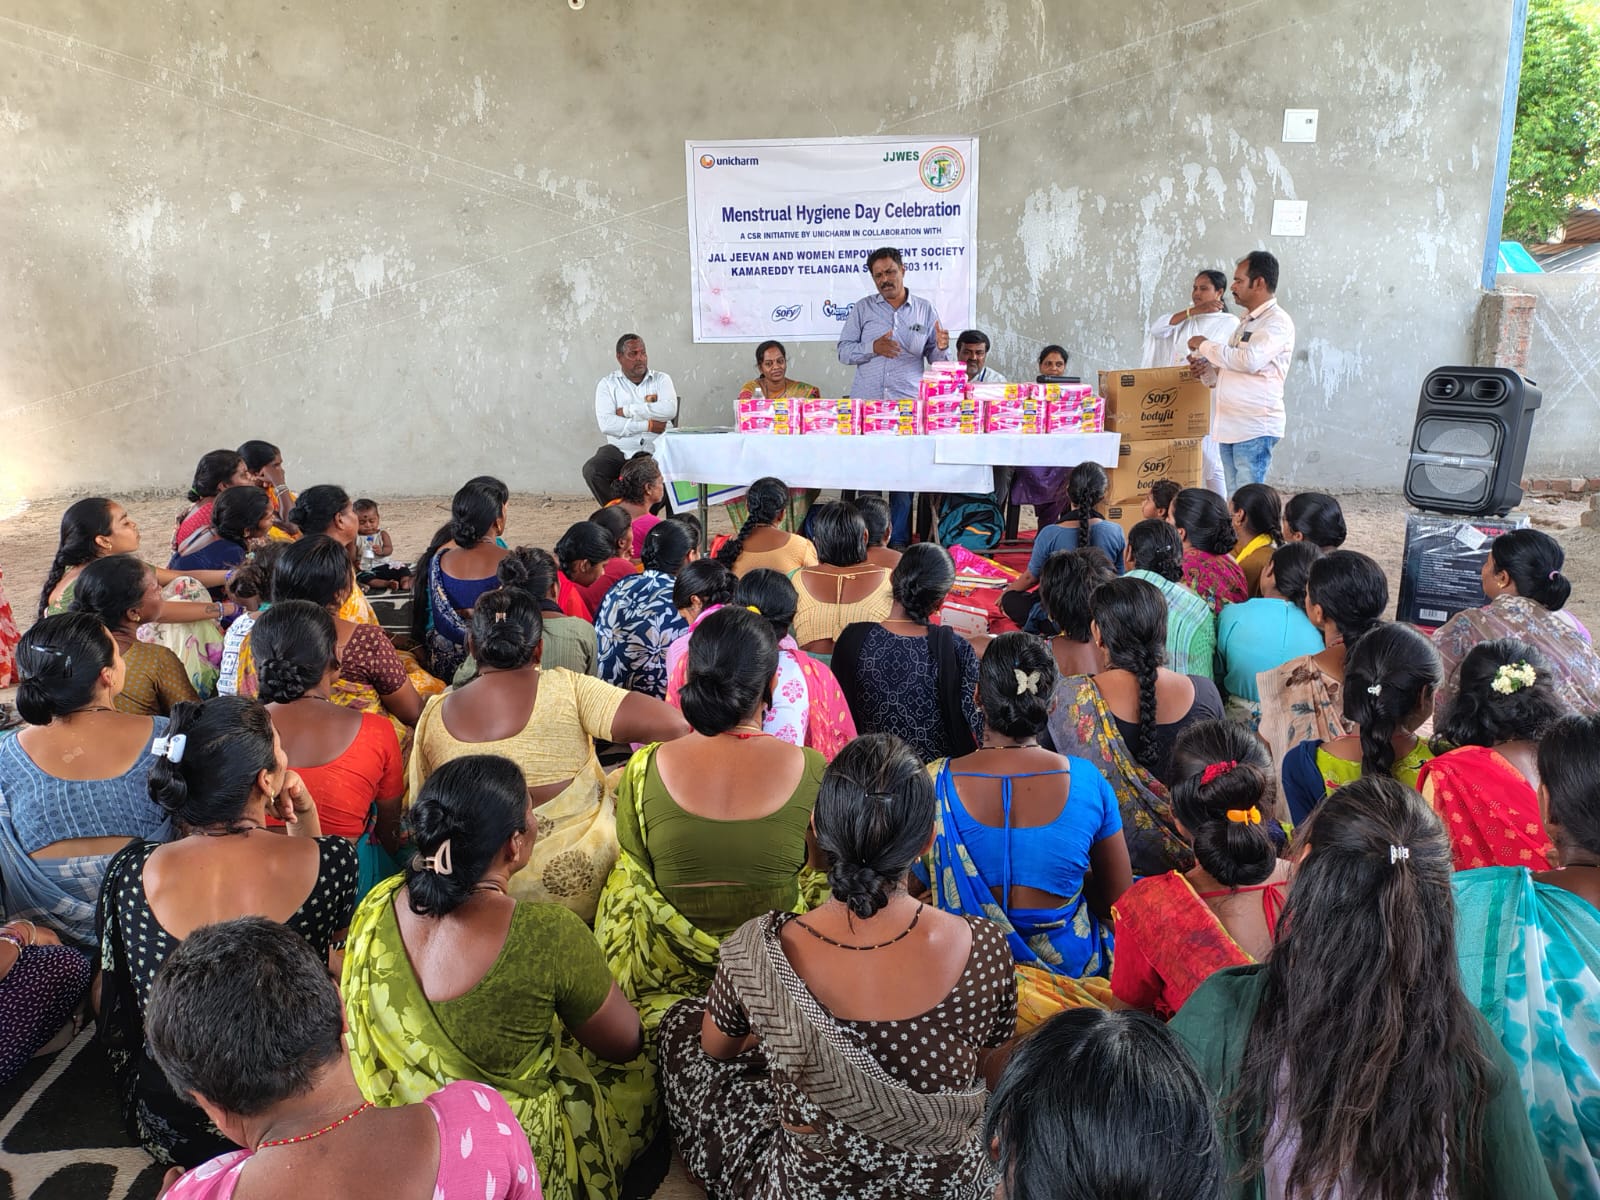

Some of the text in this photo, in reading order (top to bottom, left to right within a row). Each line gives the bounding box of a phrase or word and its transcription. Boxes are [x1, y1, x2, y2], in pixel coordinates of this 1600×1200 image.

[716, 156, 759, 166] unicharm
[883, 151, 920, 162] JJWES
[721, 201, 961, 225] Menstrual Hygiene Day Celebration
[740, 227, 942, 240] A CSR INITIATIVE BY UNICHARM IN COLLABORATION WITH
[708, 253, 727, 263] JAL
[730, 252, 769, 262] JEEVAN
[772, 251, 793, 261] AND
[796, 250, 835, 260] WOMEN
[921, 246, 965, 257] SOCIETY
[731, 265, 794, 276] KAMAREDDY
[798, 264, 860, 275] TELANGANA
[923, 261, 943, 271] 111.
[1147, 393, 1171, 404] SOFY
[1141, 409, 1174, 423] bodyfit
[1143, 462, 1166, 473] SOFY
